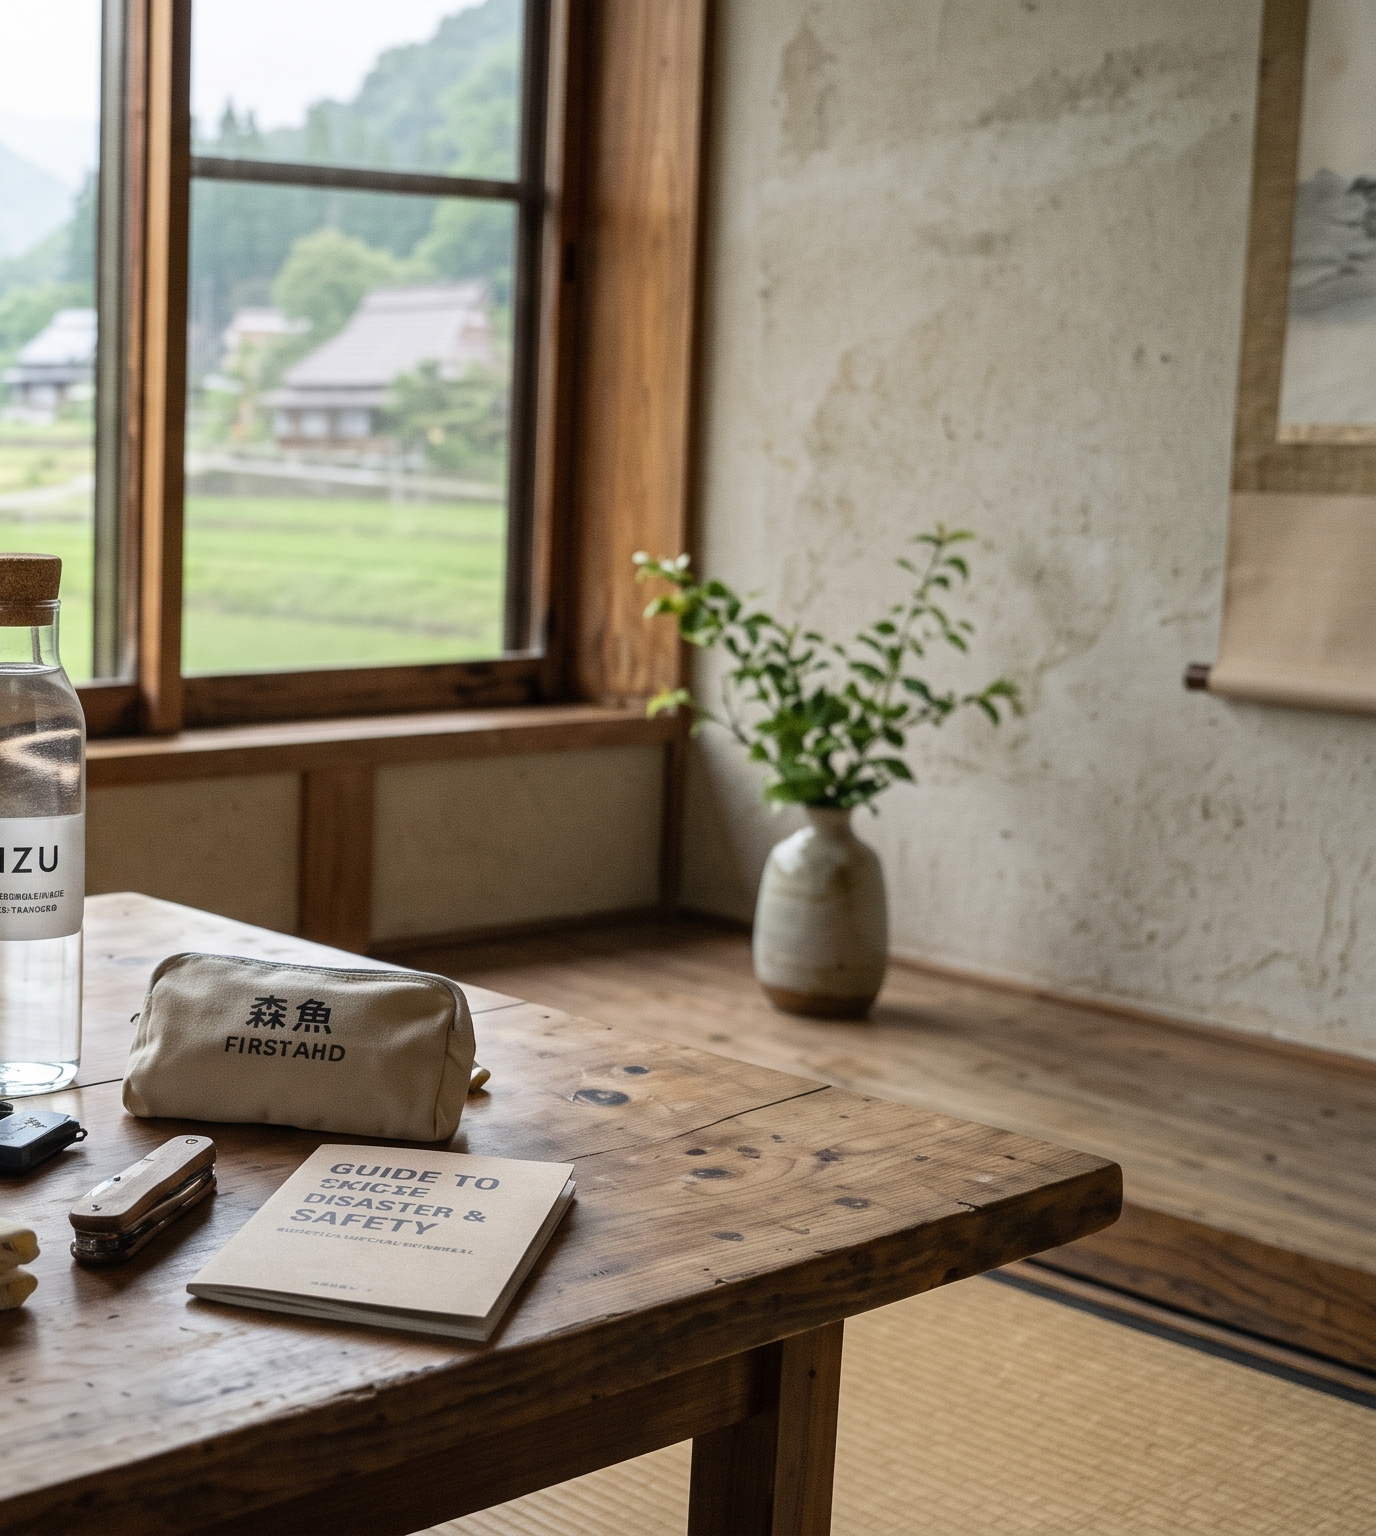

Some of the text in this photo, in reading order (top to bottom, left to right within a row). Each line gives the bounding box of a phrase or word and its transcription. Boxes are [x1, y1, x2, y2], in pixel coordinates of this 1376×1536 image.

[245, 994, 332, 1035] 森魚
[329, 1163, 500, 1191] GUIDE TO
[290, 1208, 439, 1236] SAFETY
[302, 1192, 488, 1224] DISASTER &
